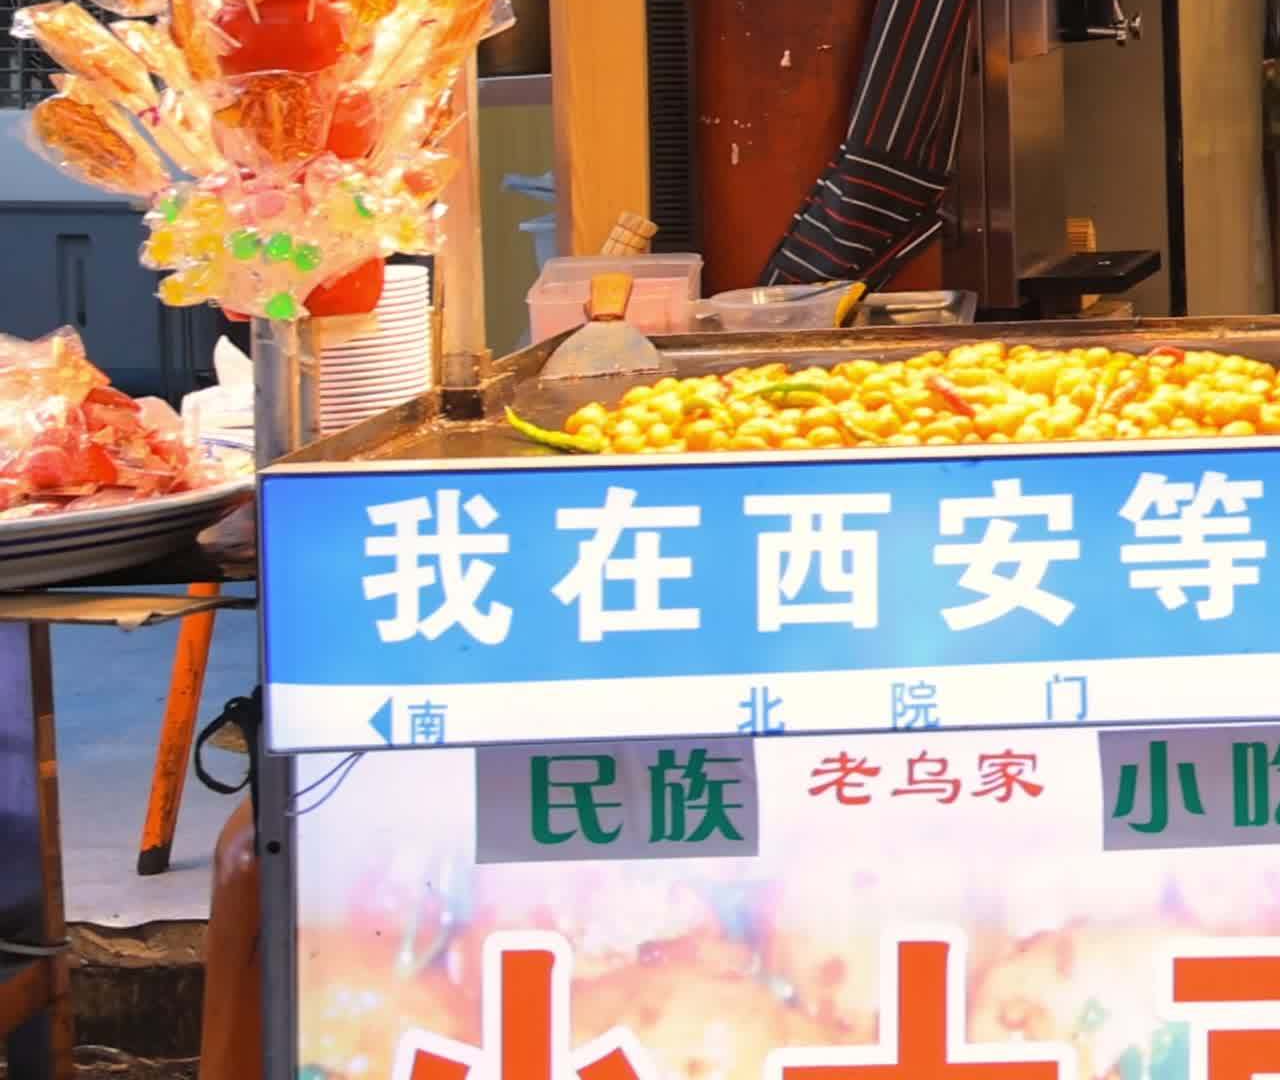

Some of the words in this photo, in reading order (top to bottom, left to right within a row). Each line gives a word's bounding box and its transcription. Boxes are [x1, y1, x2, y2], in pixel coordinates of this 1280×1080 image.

[406, 701, 448, 745] 南
[529, 747, 746, 847] 民族
[806, 749, 1045, 807] 老乌家
